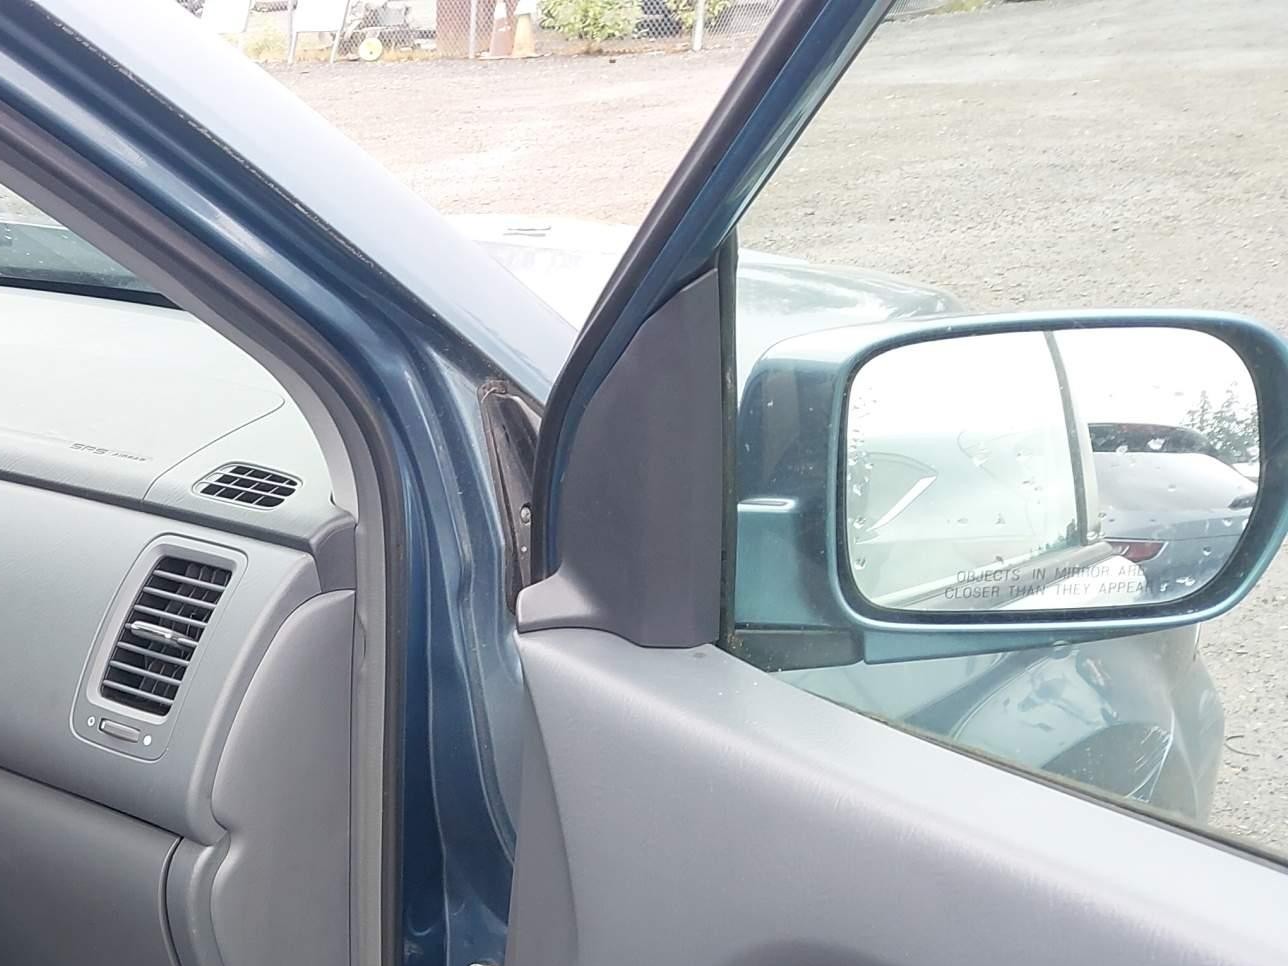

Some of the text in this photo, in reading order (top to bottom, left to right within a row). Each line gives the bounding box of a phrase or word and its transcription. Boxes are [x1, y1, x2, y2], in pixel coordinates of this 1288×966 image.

[956, 568, 1021, 583] OBJECTS
[1032, 567, 1046, 581] IN
[1055, 566, 1109, 580] MIRROR
[944, 580, 1154, 599] CLOSER THAN THEY APPEAR
